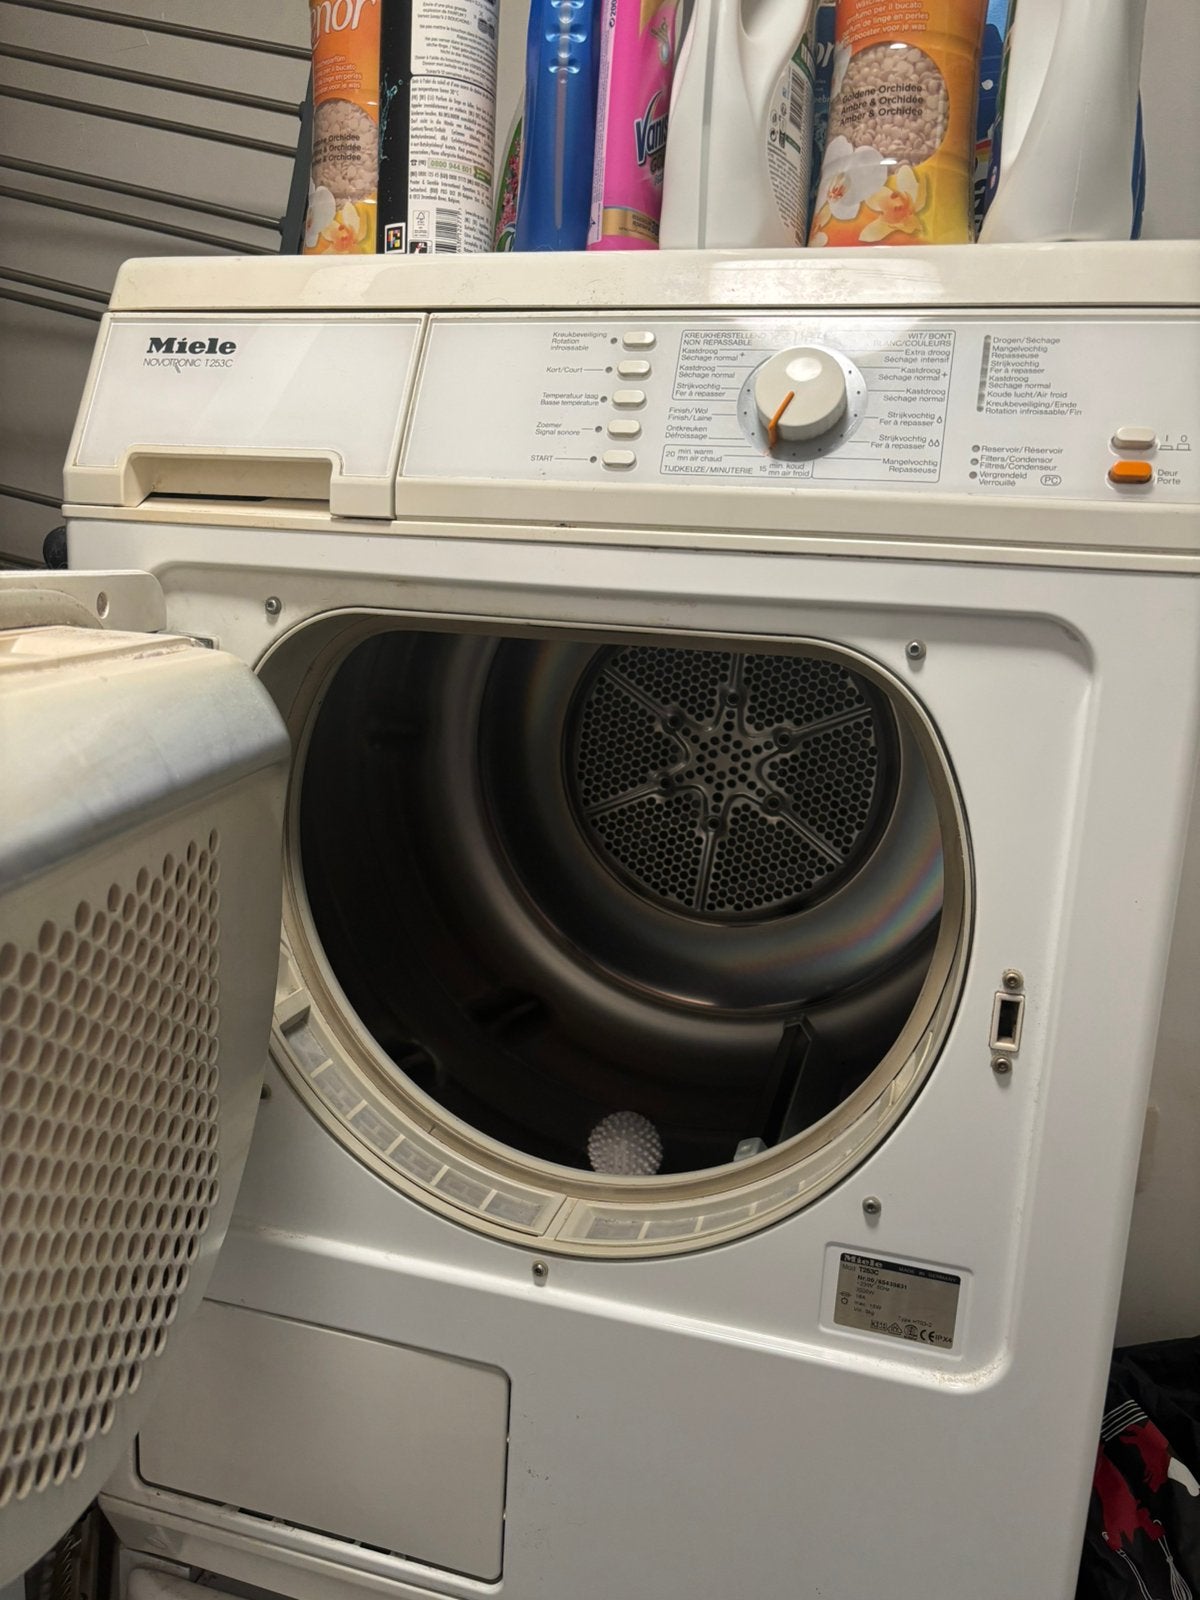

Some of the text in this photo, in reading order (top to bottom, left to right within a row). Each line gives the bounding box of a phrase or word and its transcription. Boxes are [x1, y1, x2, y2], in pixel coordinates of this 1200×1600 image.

[895, 1, 922, 9] bucato
[905, 12, 929, 21] perles
[882, 24, 900, 32] voor
[842, 87, 876, 104] Goldene
[878, 83, 923, 94] Orchidee
[841, 95, 924, 115] Ambre & Orchidée
[840, 106, 923, 126] Amber & Orchidee
[634, 91, 668, 165] Vanis
[147, 337, 237, 355] Miele
[992, 345, 1048, 353] Mangelvochtig
[928, 349, 951, 357] droog
[143, 358, 201, 368] NOVOTRONIC
[990, 360, 1040, 368] Strijkvochtig
[900, 367, 941, 375] Kastdroog
[988, 375, 1029, 383] Kastdroog
[676, 383, 721, 391] Strijkvochtig
[905, 388, 946, 396] Kastdroog
[1014, 391, 1048, 399] lucht/Air
[986, 400, 1077, 409] Kreukbeveiliging/Einde
[887, 411, 935, 420] Strijkvochtig
[1019, 408, 1082, 416] infroissable/Fin
[878, 434, 927, 443] Strijkvochtig
[882, 458, 938, 467] Mangelvochtig
[979, 462, 1058, 472] Filtres/Condenseur
[663, 465, 753, 474] TIJDKEUZE/MINUTERIE
[888, 465, 937, 474] Repasseuse
[1157, 468, 1178, 478] Deur
[979, 471, 1028, 480] Vergrendeld
[979, 478, 1016, 487] Verrouillé
[1044, 477, 1058, 485] PC
[1157, 477, 1181, 485] Porte
[843, 1254, 883, 1268] Miele
[859, 1266, 879, 1276] T253C
[899, 1266, 915, 1274] MADE
[928, 1273, 957, 1282] GERMANY
